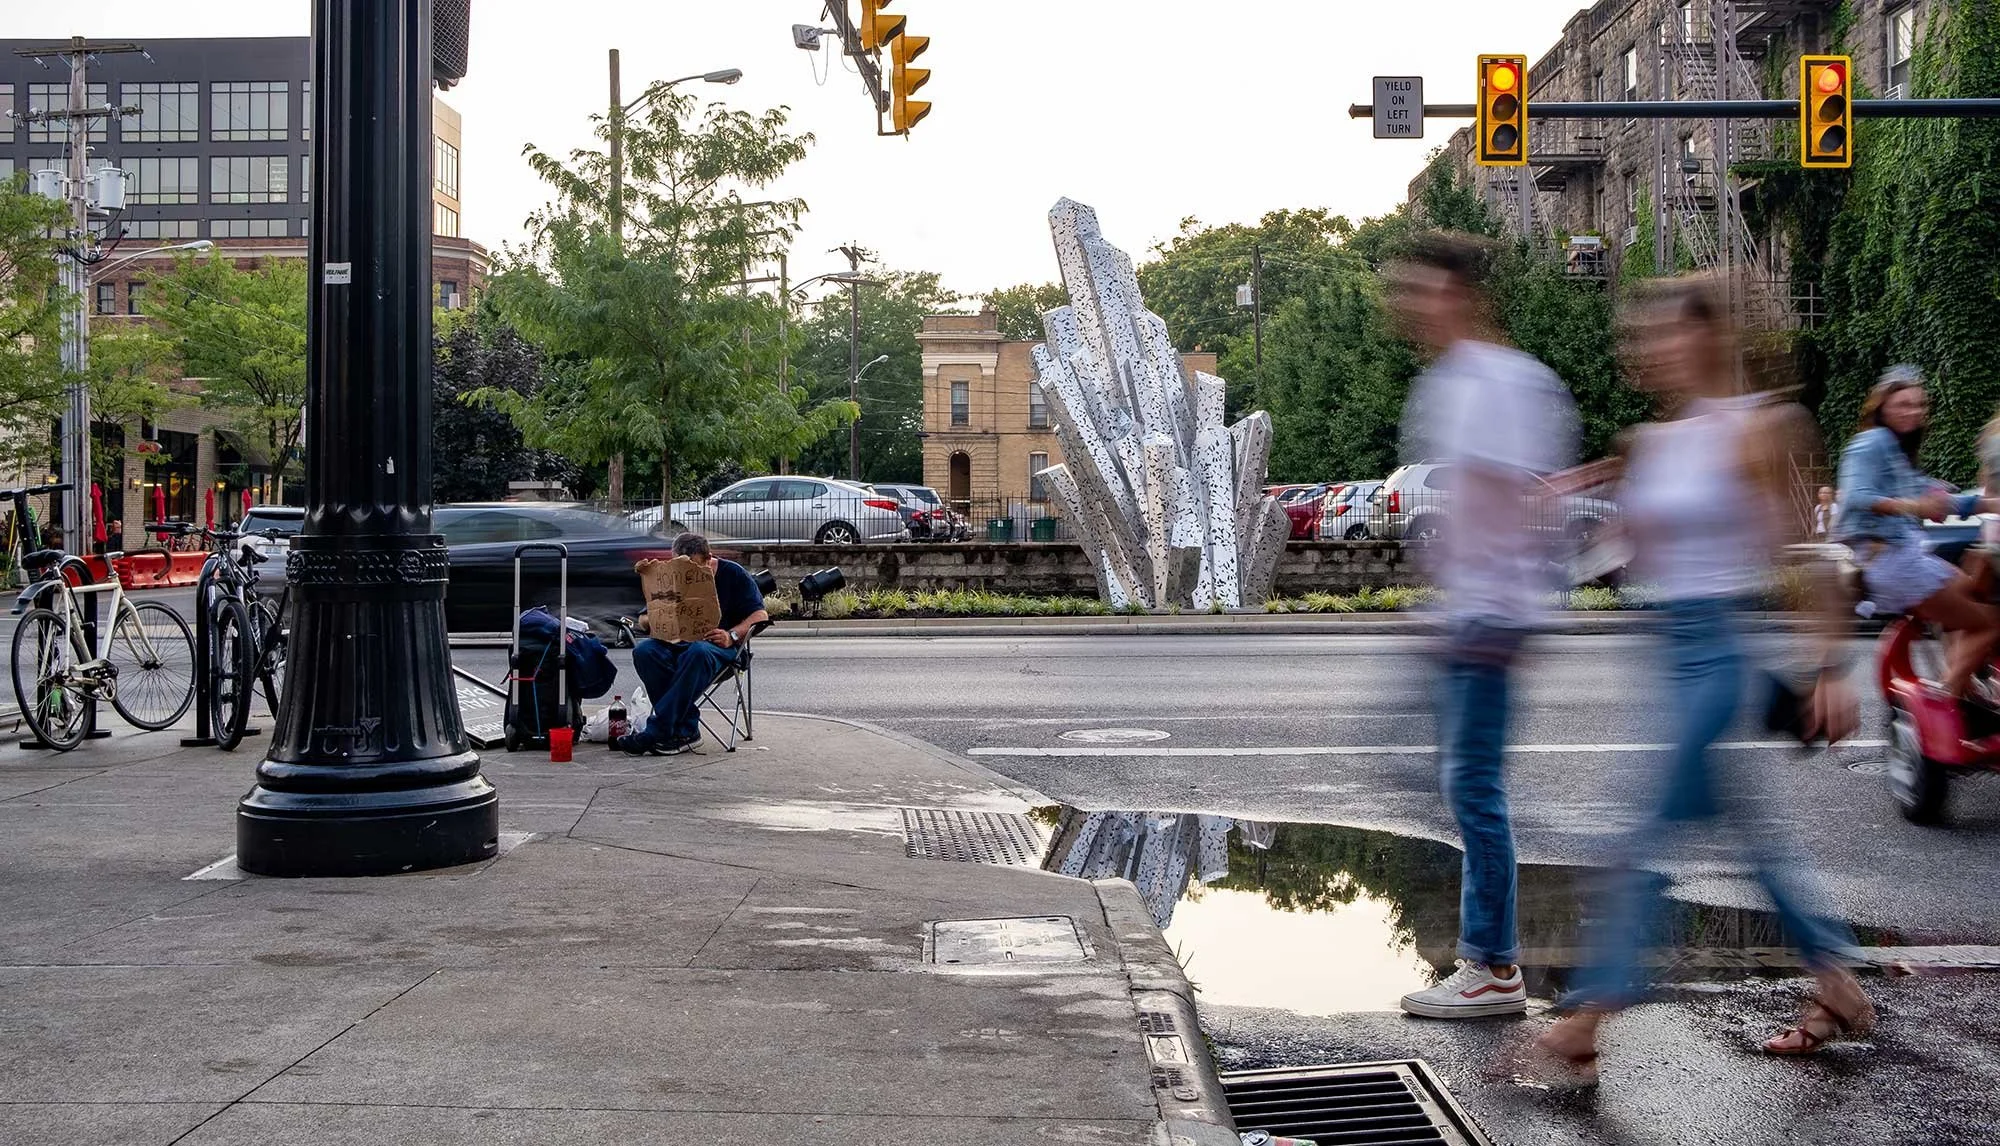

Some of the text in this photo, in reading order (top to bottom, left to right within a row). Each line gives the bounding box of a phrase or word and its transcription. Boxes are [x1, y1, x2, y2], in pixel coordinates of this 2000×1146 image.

[1384, 81, 1411, 91] YIELD
[1391, 95, 1405, 105] ON
[1387, 109, 1409, 119] LEFT
[1386, 124, 1411, 134] TURN
[659, 605, 704, 618] PLEASE
[655, 623, 688, 638] HELP
